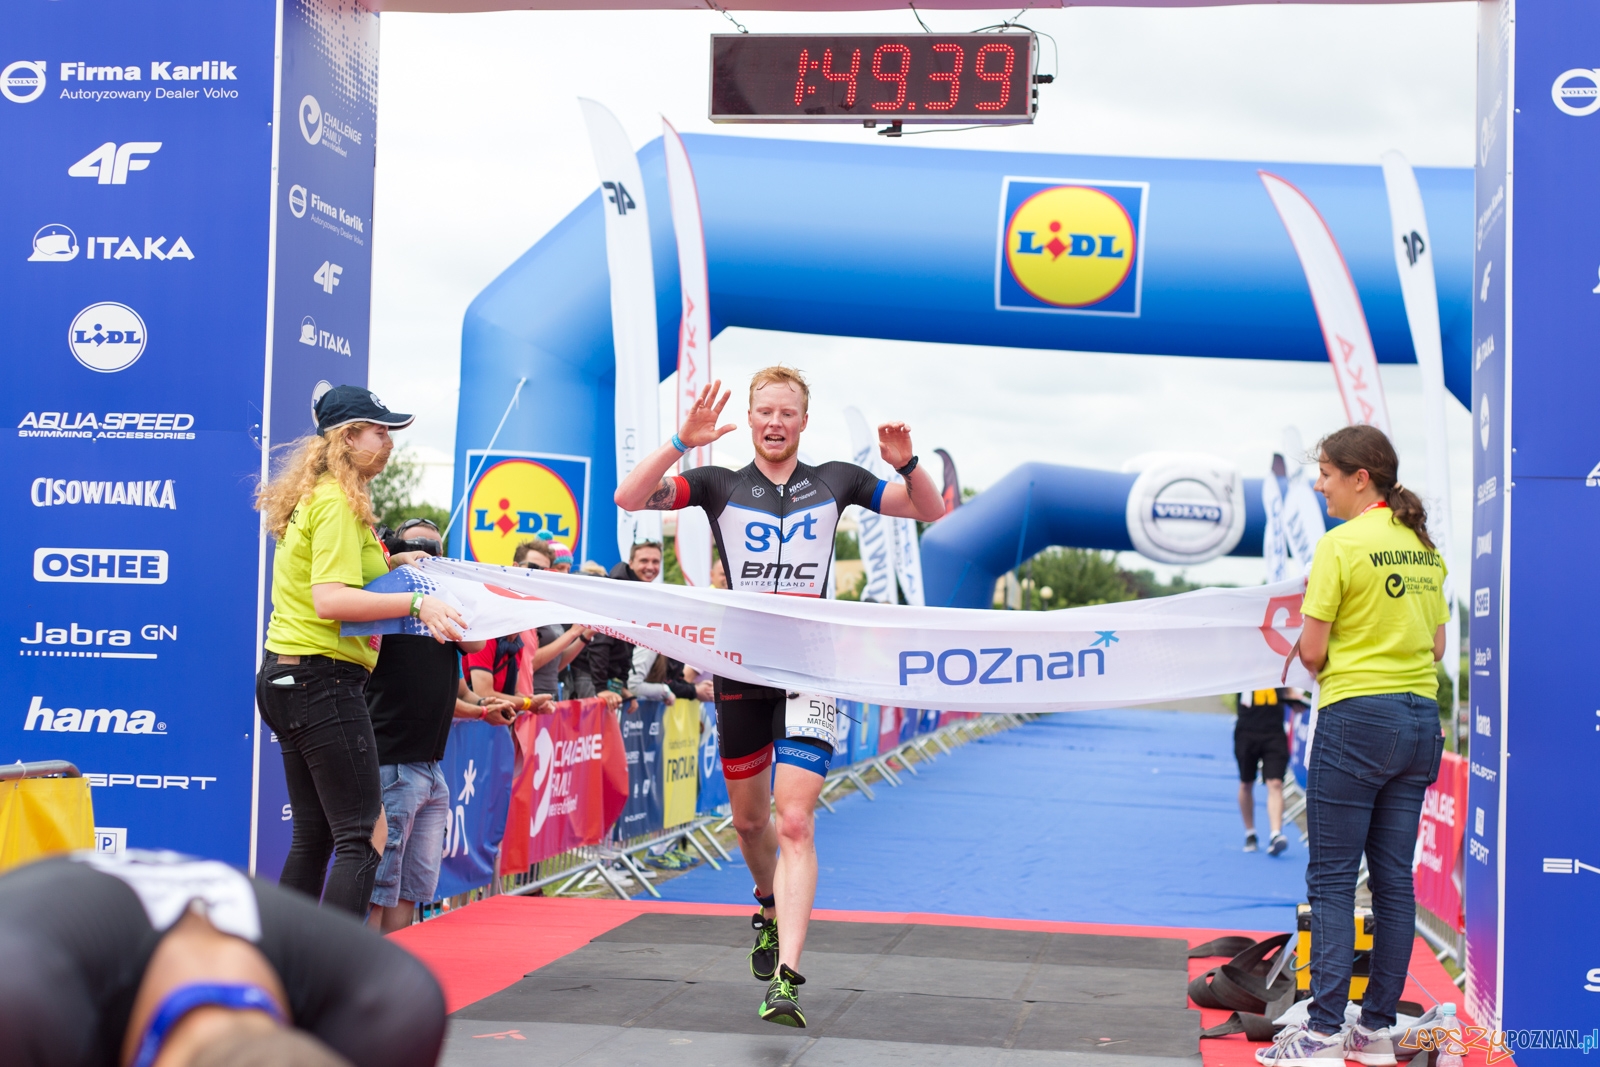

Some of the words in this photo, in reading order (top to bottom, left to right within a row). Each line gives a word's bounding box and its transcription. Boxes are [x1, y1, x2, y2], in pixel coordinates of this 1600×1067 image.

[60, 62, 141, 81] Firma
[151, 61, 238, 81] Karlik
[60, 88, 152, 102] Autoryzowany
[155, 88, 200, 99] Dealer
[203, 88, 239, 99] Volvo
[324, 112, 362, 145] CHALLENGE
[68, 142, 163, 185] 4F
[311, 193, 338, 219] Firma
[339, 207, 364, 233] Karlik
[87, 236, 195, 260] ITAKA
[313, 260, 343, 294] 4F
[319, 330, 351, 357] ITAKA
[18, 430, 93, 438] SWIMMING
[96, 431, 196, 440] ACCESSORIES
[31, 477, 176, 510] CISOWIANKA
[1154, 504, 1220, 518] VOLVO
[745, 512, 818, 552] gvt
[42, 554, 160, 579] OSHEE
[741, 561, 819, 579] BMC
[1369, 550, 1441, 568] WOLONTARIUS
[20, 622, 131, 646] Jabra
[141, 625, 177, 641] GN
[24, 696, 156, 734] hama
[809, 699, 835, 723] 518
[82, 773, 217, 790] SPORT
